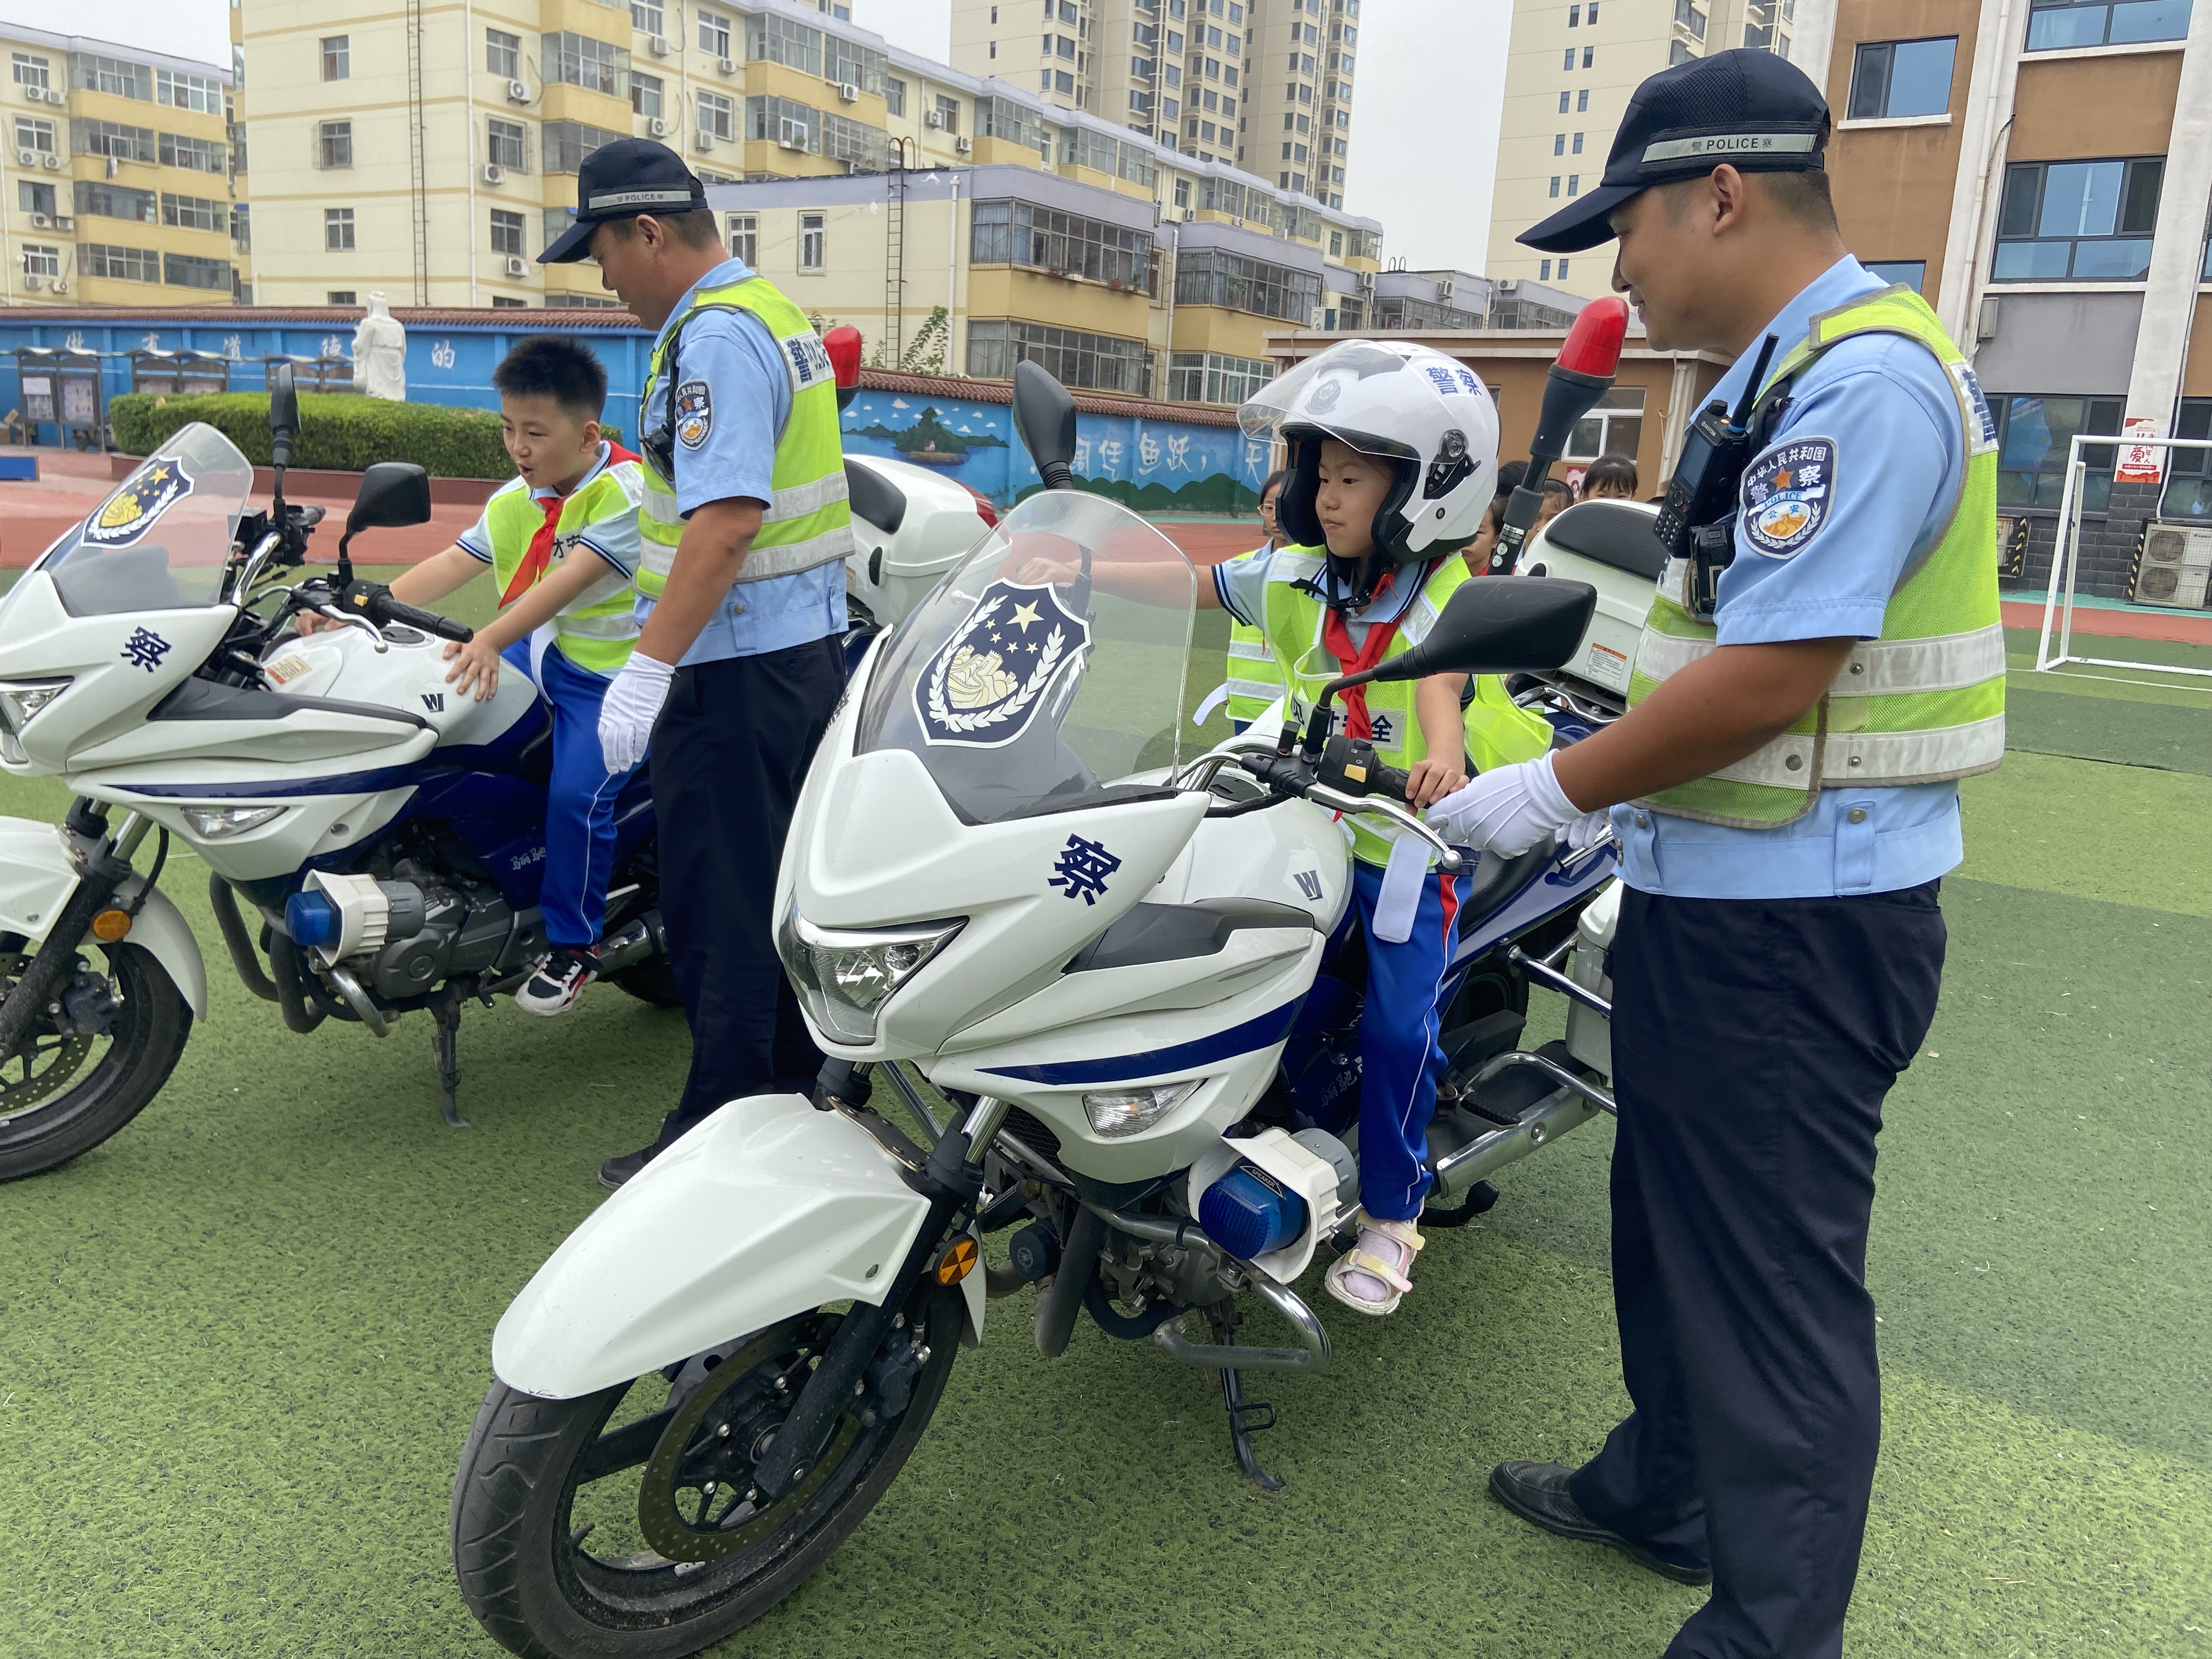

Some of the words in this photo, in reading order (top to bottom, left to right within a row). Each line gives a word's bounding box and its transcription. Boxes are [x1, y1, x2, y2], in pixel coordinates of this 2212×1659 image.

[1707, 138, 1758, 150] POLICE
[431, 339, 456, 370] 的
[677, 386, 705, 403] 人民共和国
[1426, 366, 1482, 396] 警察
[1747, 446, 1827, 487] 中华人民共和国
[1750, 482, 1769, 504] 警
[1798, 465, 1822, 487] 察
[1764, 491, 1803, 508] POLICE
[1768, 510, 1778, 519] 公
[1790, 504, 1800, 514] 安
[120, 626, 172, 673] 察
[1047, 833, 1122, 906] 察
[1251, 1169, 1276, 1188] SPEAKER
